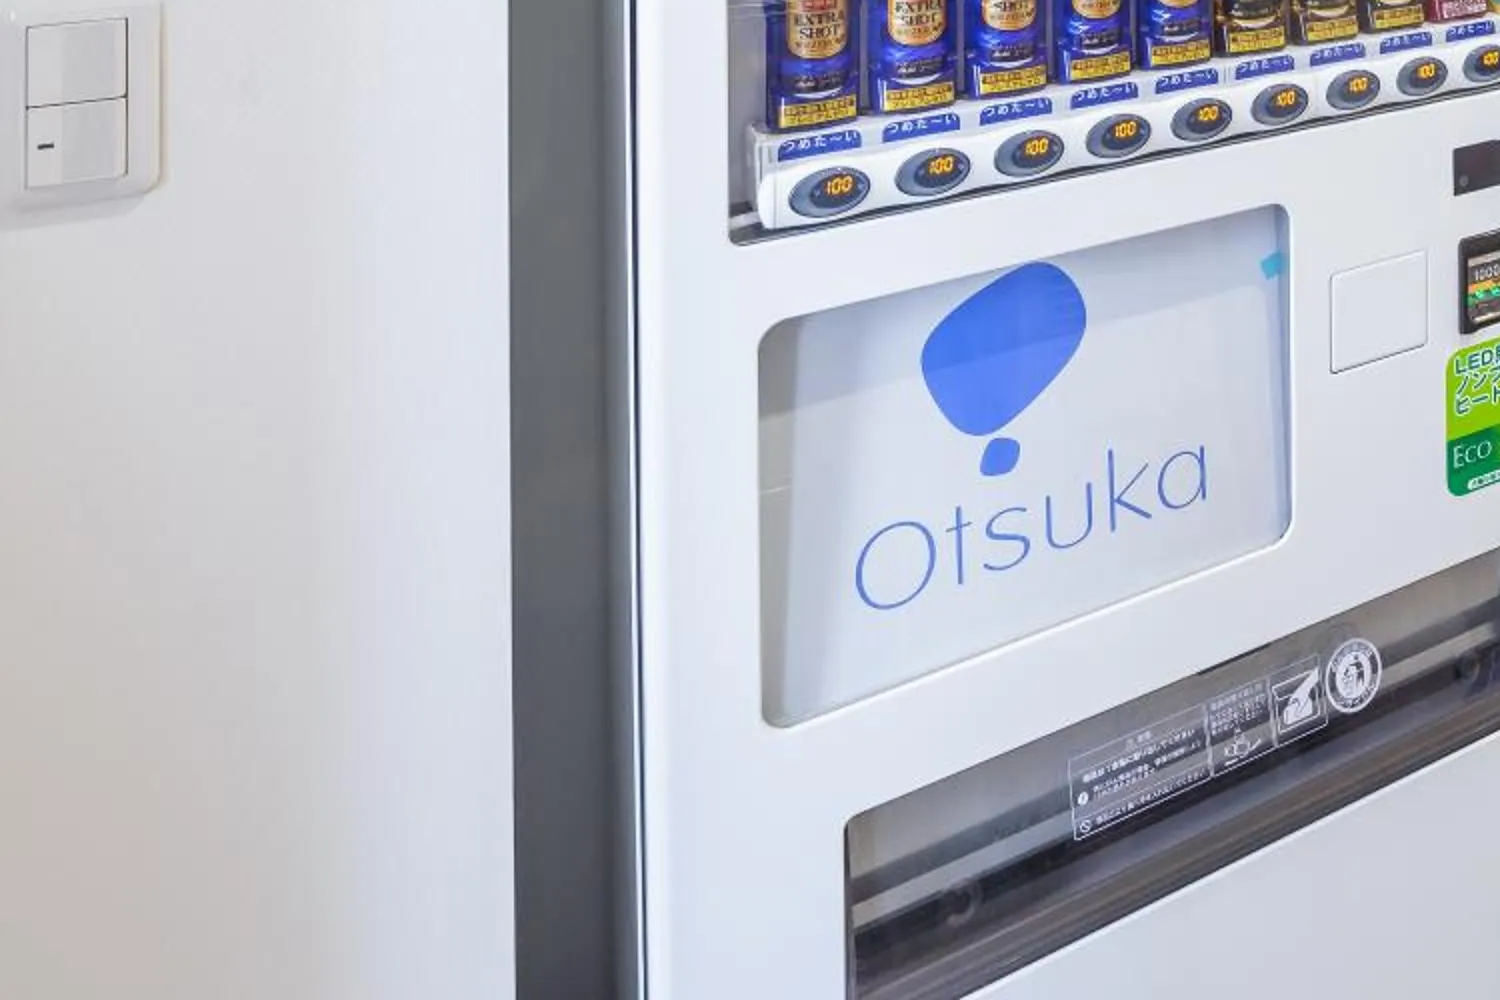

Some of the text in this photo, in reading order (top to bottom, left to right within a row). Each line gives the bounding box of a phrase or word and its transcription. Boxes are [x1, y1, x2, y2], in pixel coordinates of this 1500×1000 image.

[896, 0, 943, 14] EXTRA
[794, 9, 845, 26] EXTRA
[900, 12, 938, 25] SHOT
[800, 24, 841, 40] SHOT
[1115, 120, 1137, 138] 100
[1026, 137, 1049, 155] 100
[929, 157, 953, 175] 100
[827, 176, 852, 195] 100
[855, 445, 1208, 611] Otsuka
